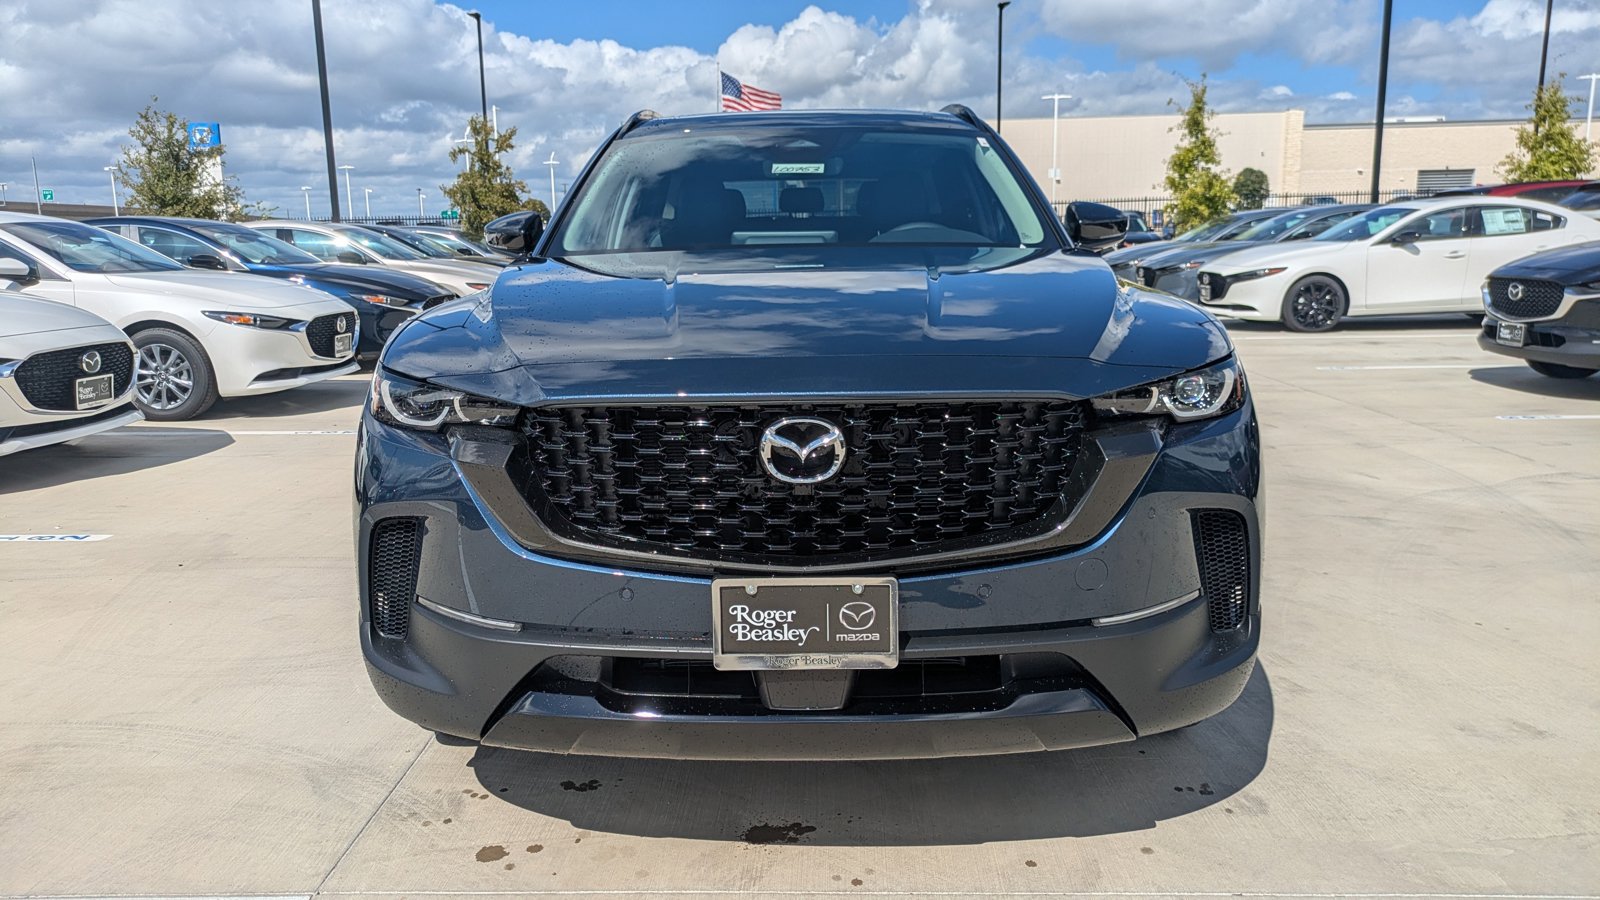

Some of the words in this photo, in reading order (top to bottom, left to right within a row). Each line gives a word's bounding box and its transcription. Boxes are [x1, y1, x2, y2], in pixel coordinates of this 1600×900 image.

[729, 605, 796, 628] Roger
[729, 623, 820, 646] Beasley
[836, 633, 880, 642] mazda
[766, 655, 800, 667] Roger
[801, 655, 844, 667] Beasley
